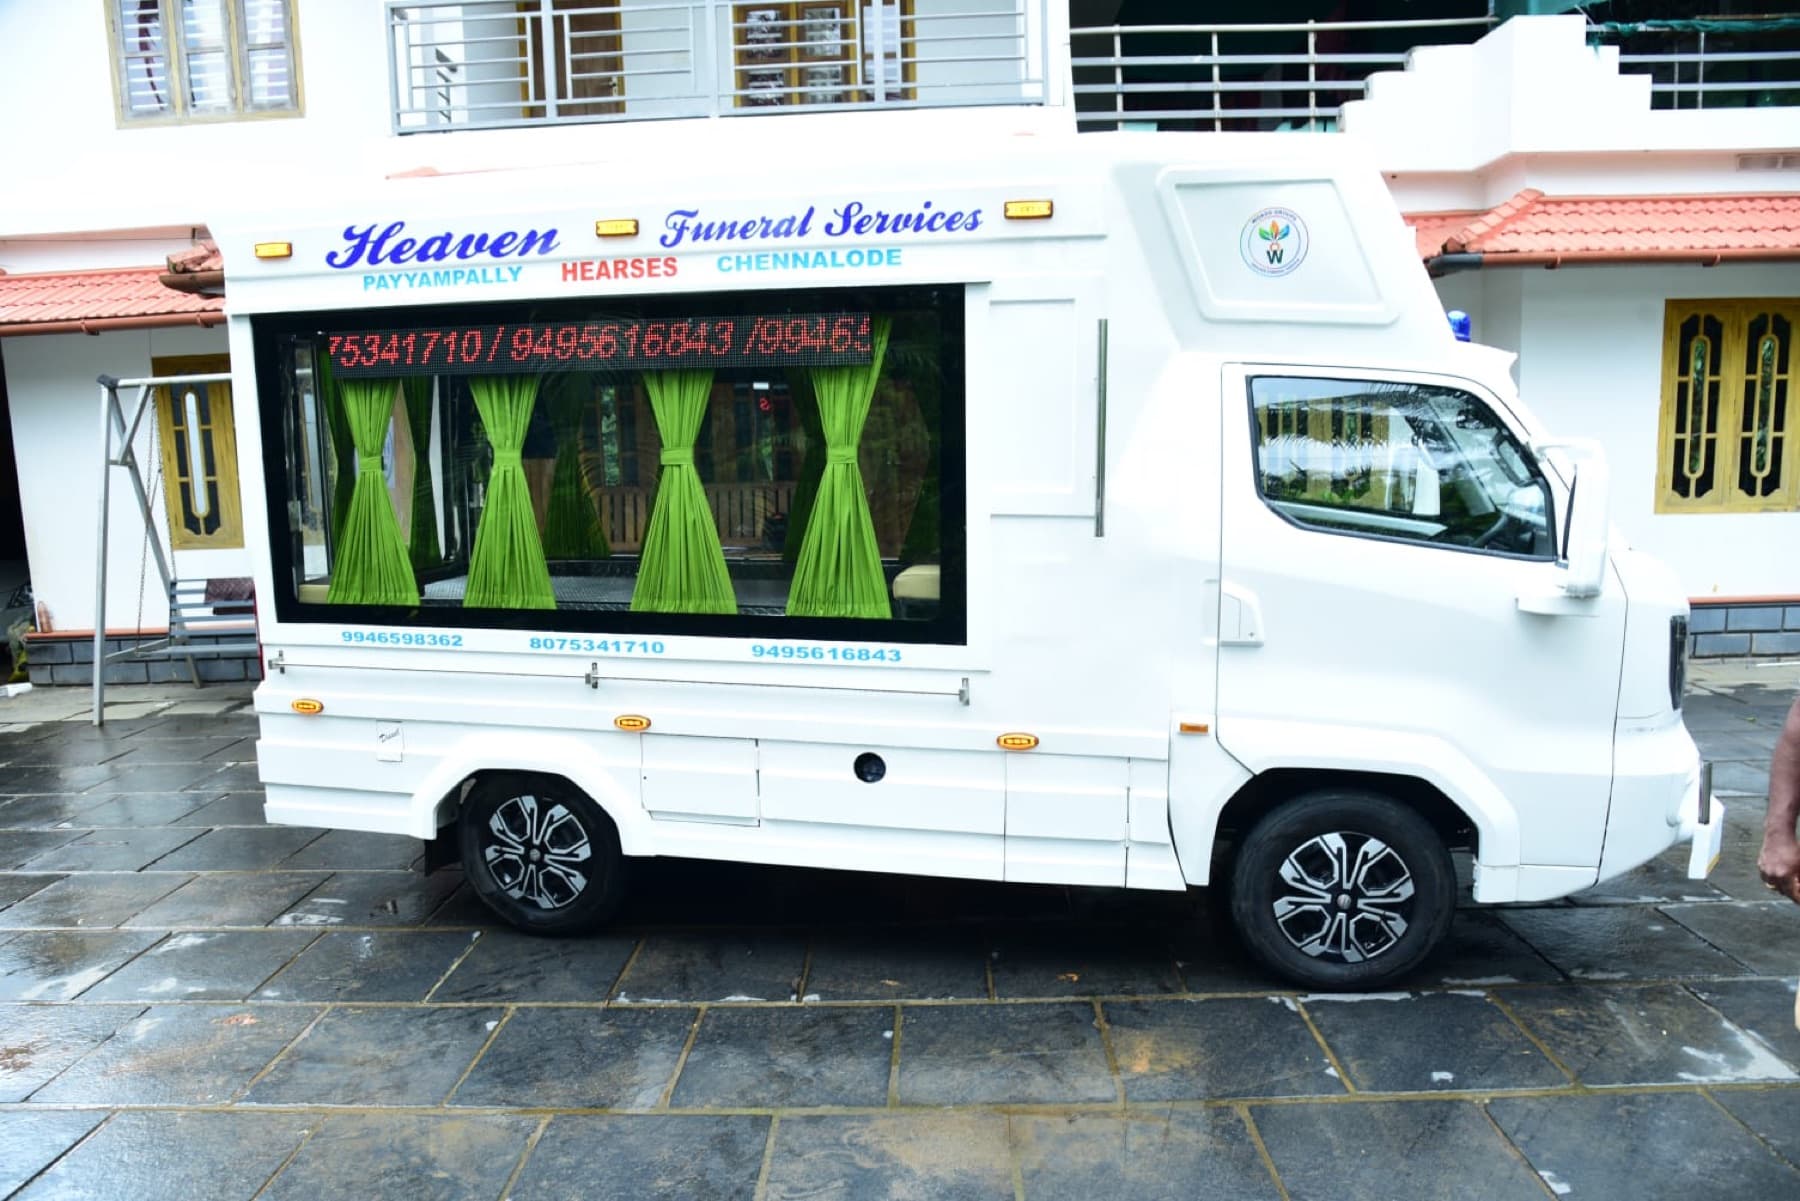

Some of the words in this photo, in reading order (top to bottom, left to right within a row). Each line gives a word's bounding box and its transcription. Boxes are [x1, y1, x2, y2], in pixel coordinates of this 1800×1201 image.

[326, 221, 560, 268] Heaven
[660, 205, 814, 248] Funeral
[825, 201, 983, 237] Services
[561, 256, 679, 282] HEARSES
[716, 248, 903, 273] CHENNALODE
[362, 267, 522, 290] PAYYAMPALLY
[341, 629, 463, 648] 9946598362
[529, 636, 666, 657] 8075341710
[751, 645, 902, 664] 9495616843
